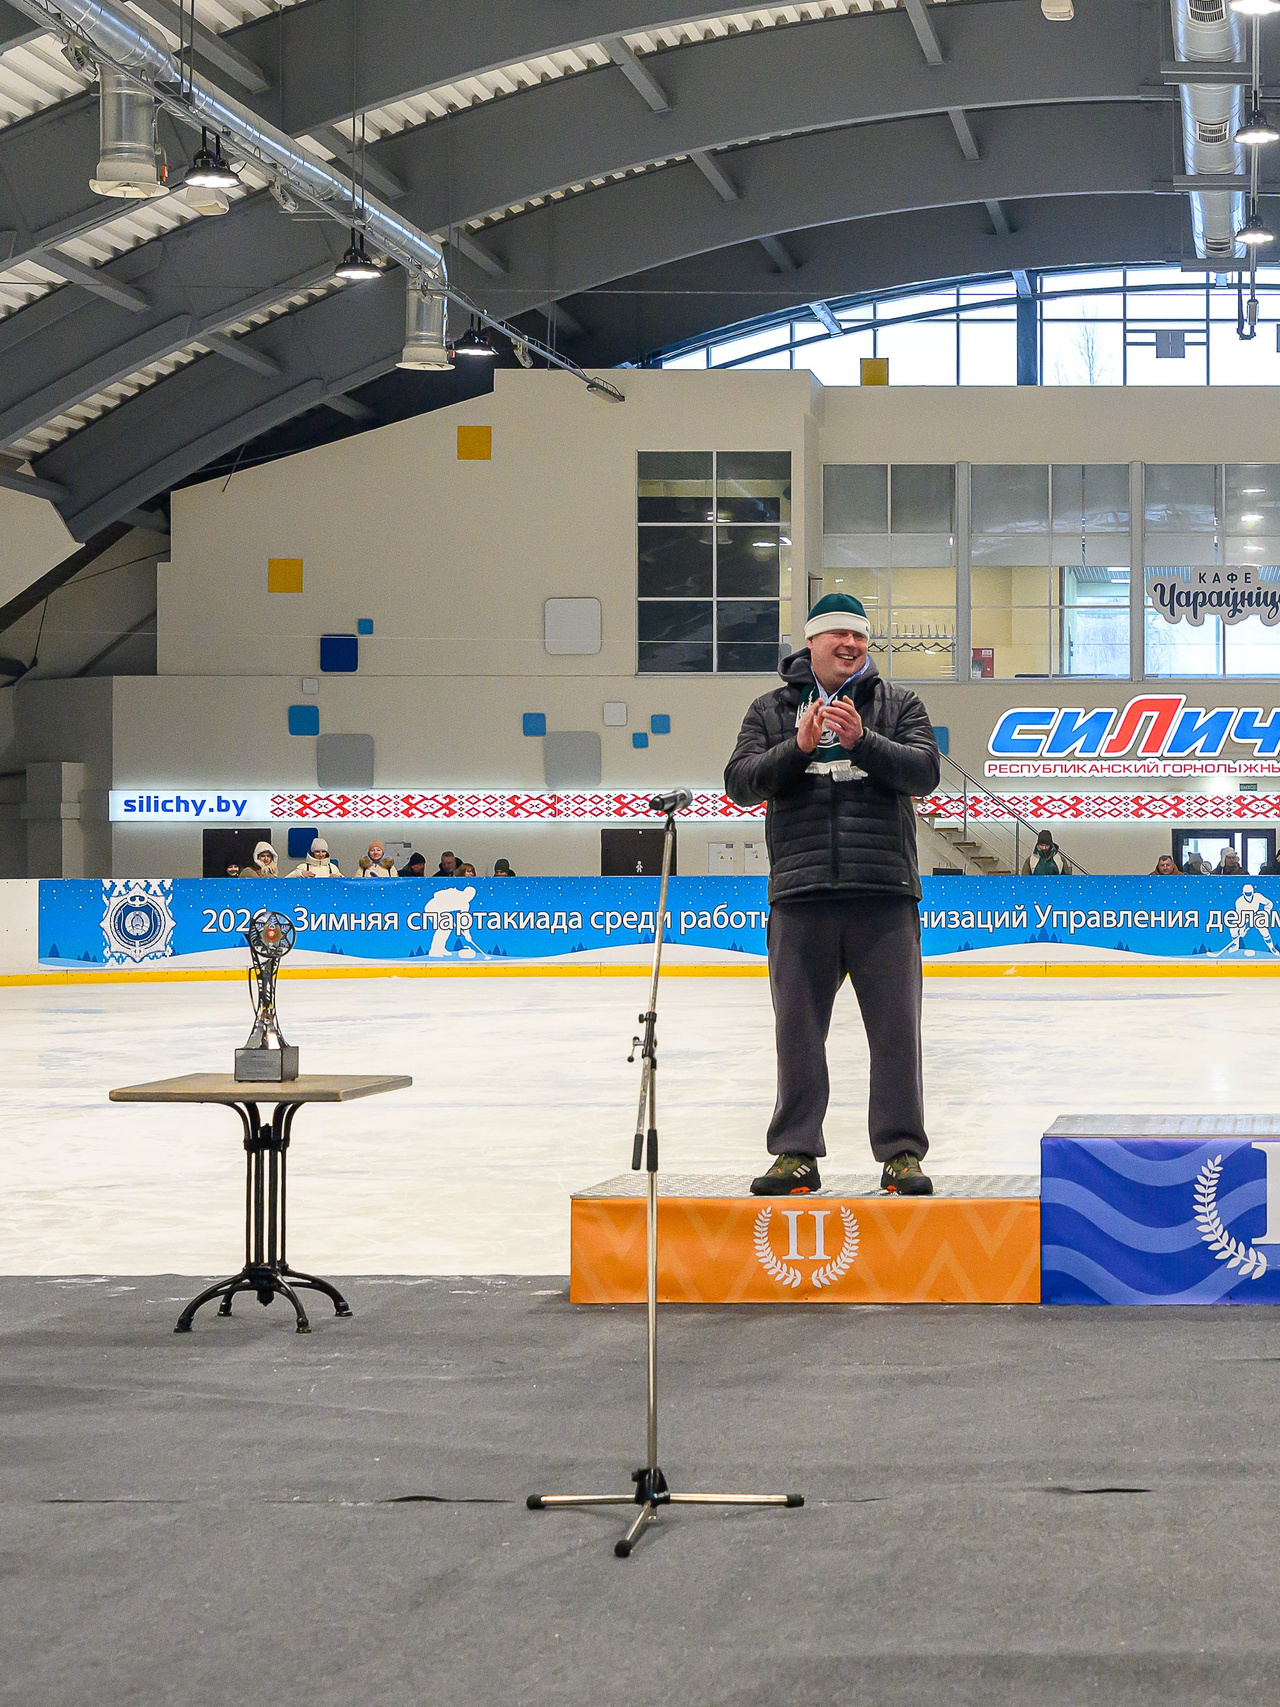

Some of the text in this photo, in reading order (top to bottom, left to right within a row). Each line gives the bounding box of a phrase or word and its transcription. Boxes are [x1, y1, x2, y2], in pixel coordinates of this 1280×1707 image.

[1198, 572, 1252, 584] КАФЕ
[988, 761, 1159, 774] РЕСПУБЛИКАНСКИЙ
[123, 795, 248, 817] silichy.by
[293, 907, 398, 932] Зимняя
[406, 911, 583, 936] спартакиада
[590, 910, 671, 936] среди
[1034, 904, 1199, 935] Управления
